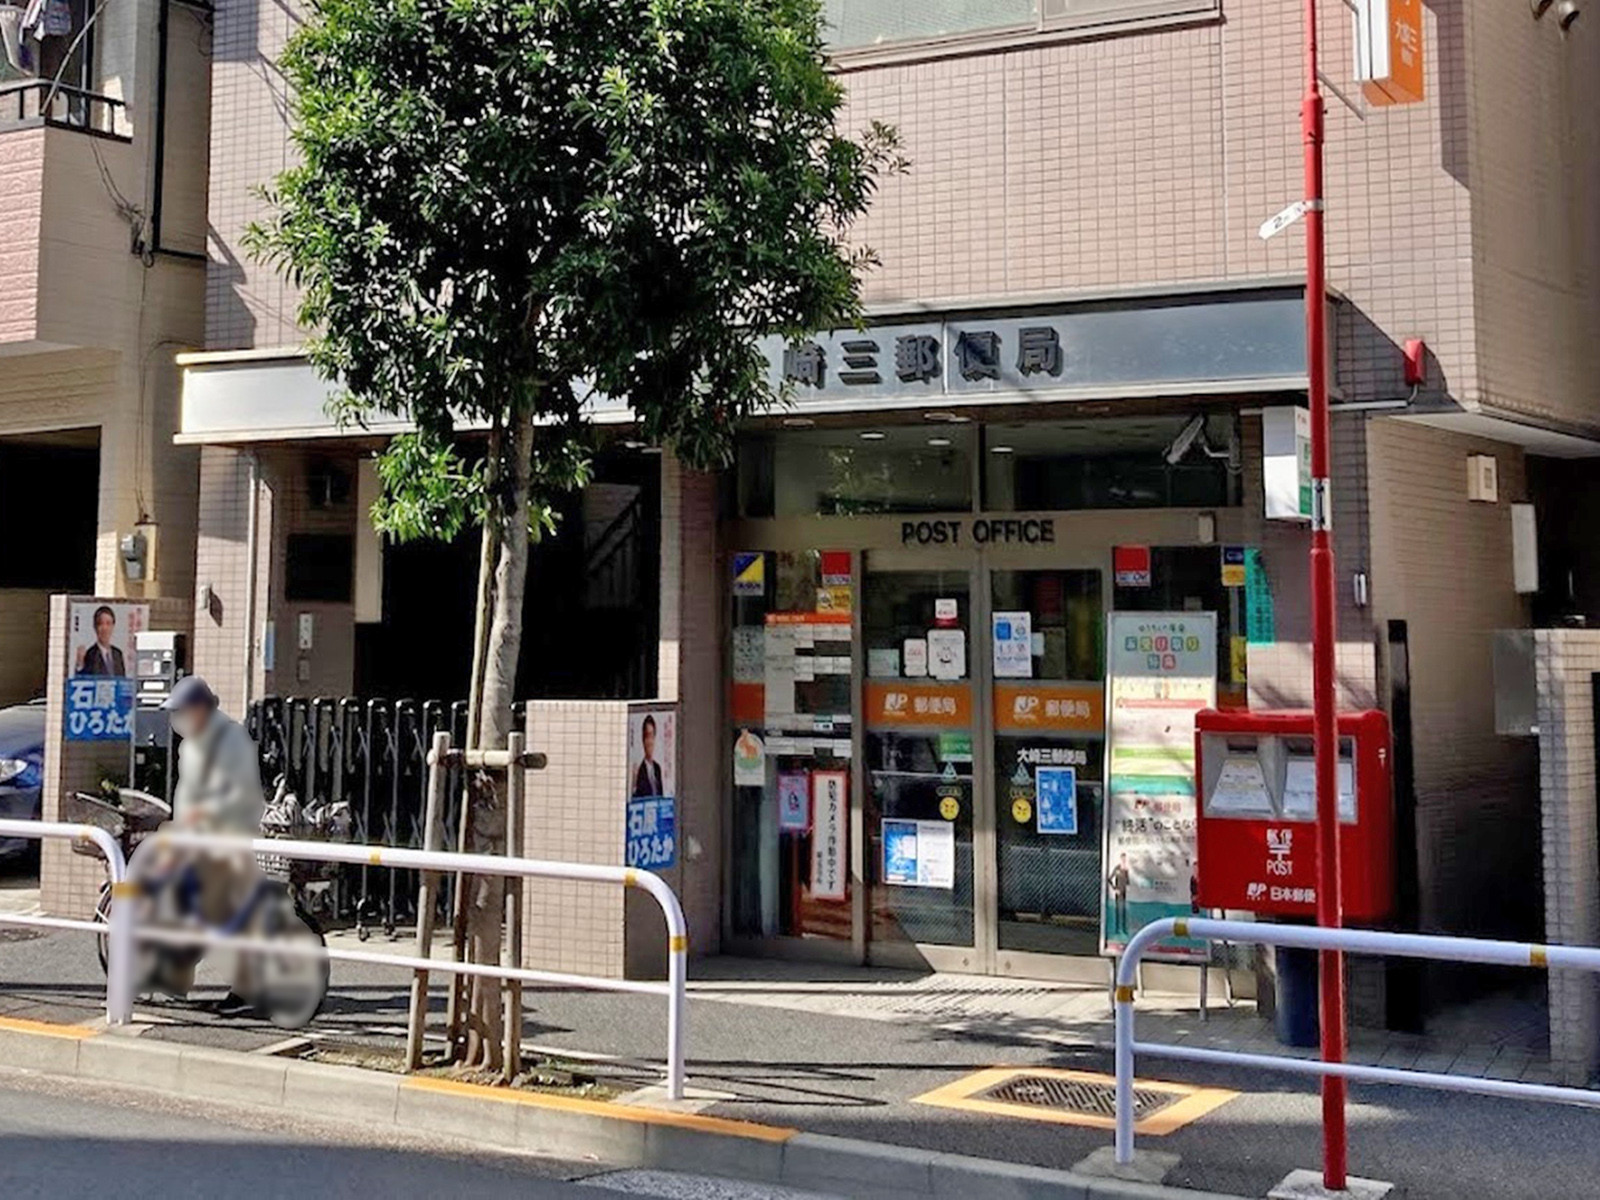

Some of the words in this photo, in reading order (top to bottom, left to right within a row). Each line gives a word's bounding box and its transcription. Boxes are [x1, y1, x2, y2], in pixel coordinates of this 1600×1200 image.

[901, 521, 961, 544] POST
[972, 519, 1054, 543] OFFICE
[71, 680, 118, 710] 石原
[1017, 747, 1087, 765] 大崎三郵便局
[629, 801, 659, 836] 石原
[628, 834, 674, 866] ひろたか
[1266, 859, 1293, 876] POST
[1270, 886, 1316, 903] 日本郵便
